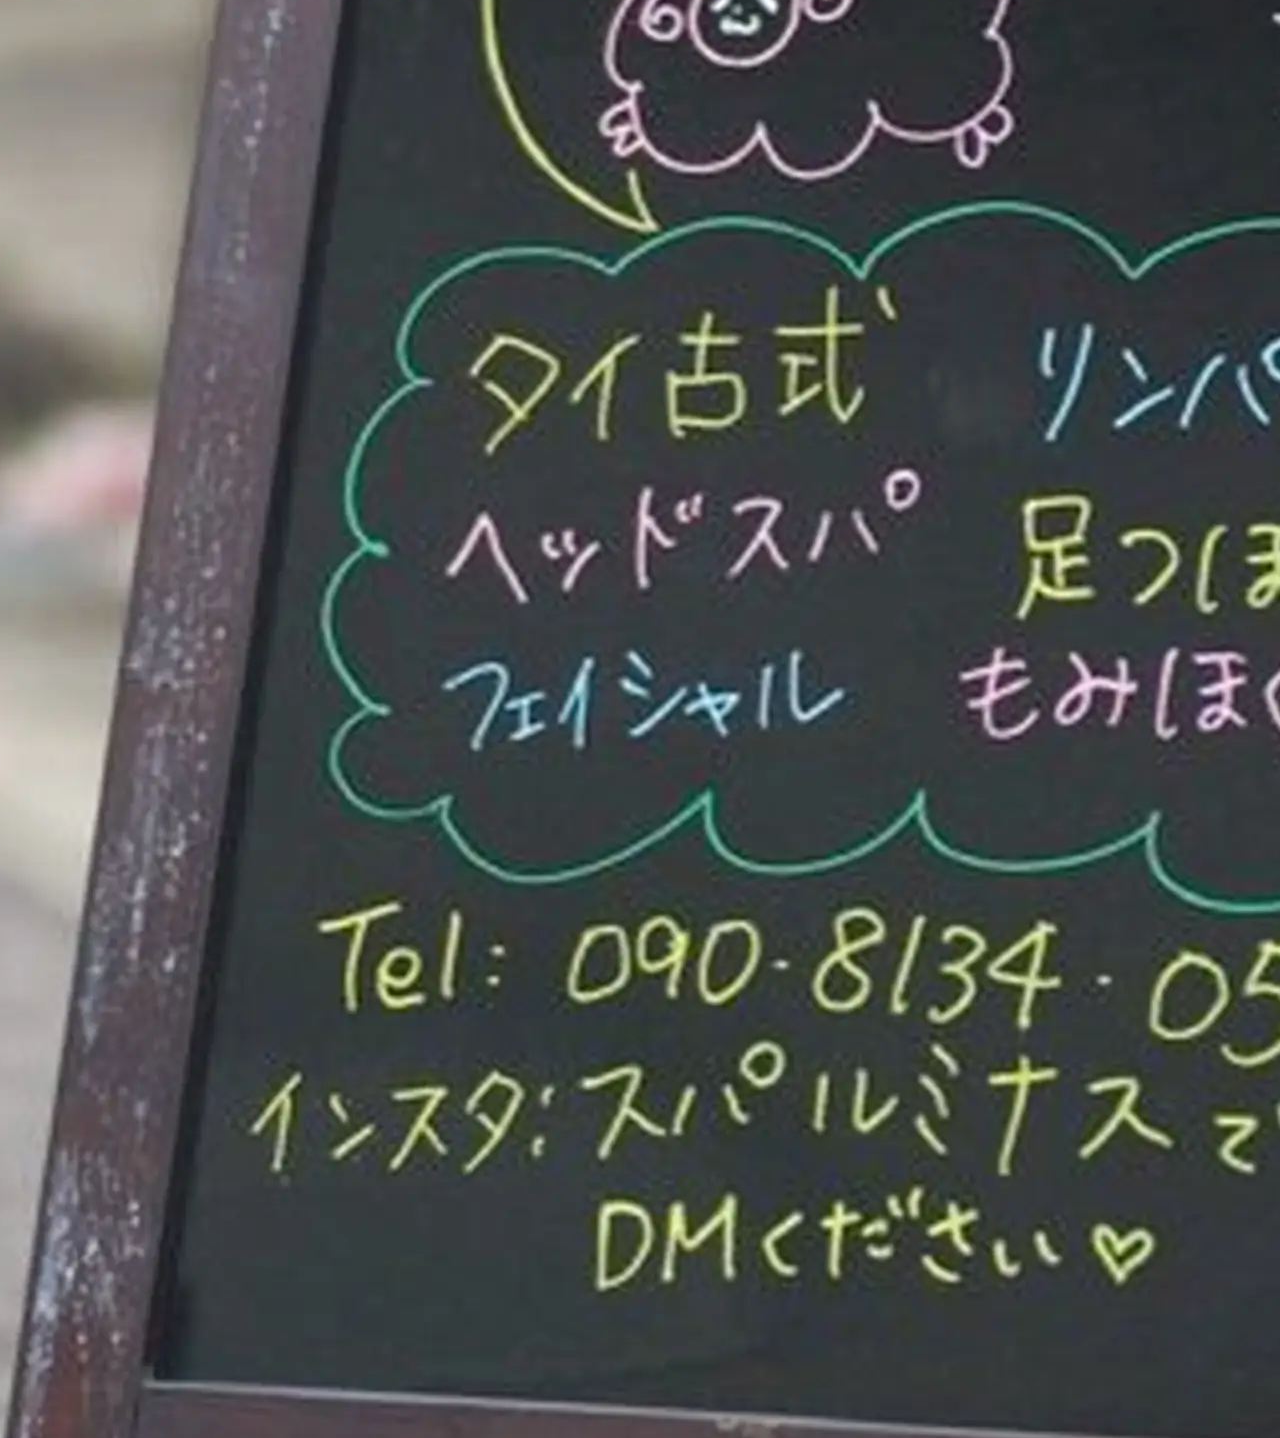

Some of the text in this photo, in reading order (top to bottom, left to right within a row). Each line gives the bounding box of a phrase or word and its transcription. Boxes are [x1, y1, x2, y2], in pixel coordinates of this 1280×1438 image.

[469, 285, 897, 456] タイ古式
[445, 468, 922, 604] ヘッドスパ
[442, 650, 846, 751] フェイシャル
[318, 901, 506, 1012] Tel:
